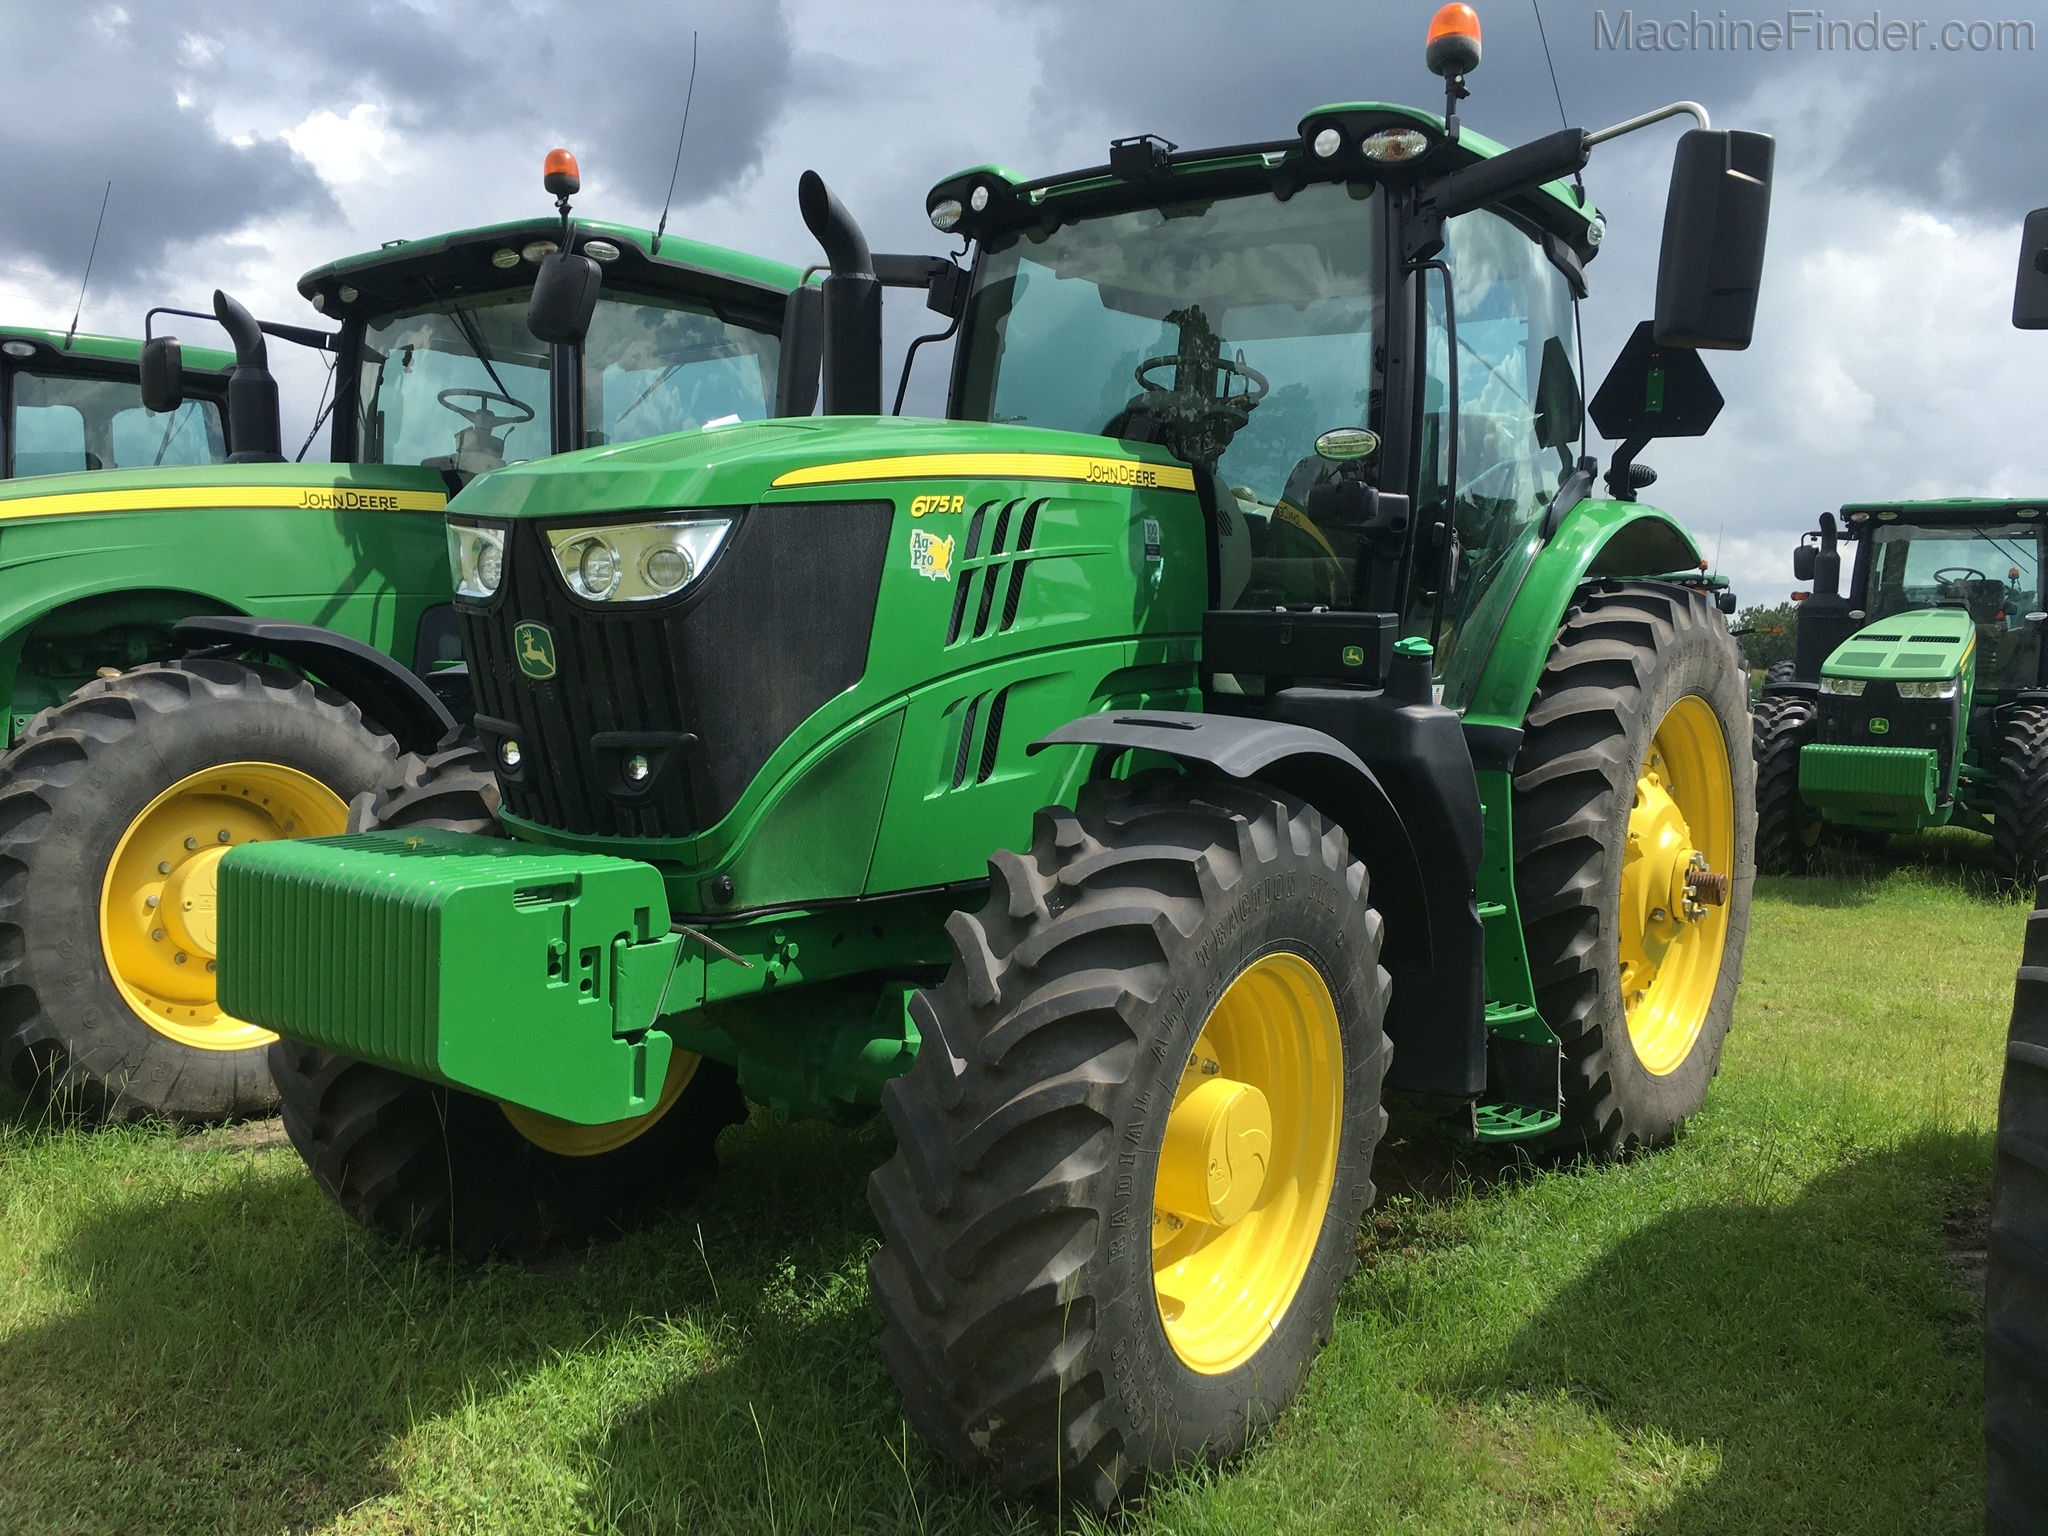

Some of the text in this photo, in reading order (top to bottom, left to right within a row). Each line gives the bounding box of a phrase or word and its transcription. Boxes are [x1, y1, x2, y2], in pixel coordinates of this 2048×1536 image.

[1086, 462, 1157, 485] JOHN DEERE
[299, 491, 399, 509] JOHN DEERE
[911, 495, 964, 518] 6175R
[913, 549, 934, 567] Pro
[1108, 1091, 1151, 1264] RADIAL
[1195, 869, 1297, 968] TRACTION
